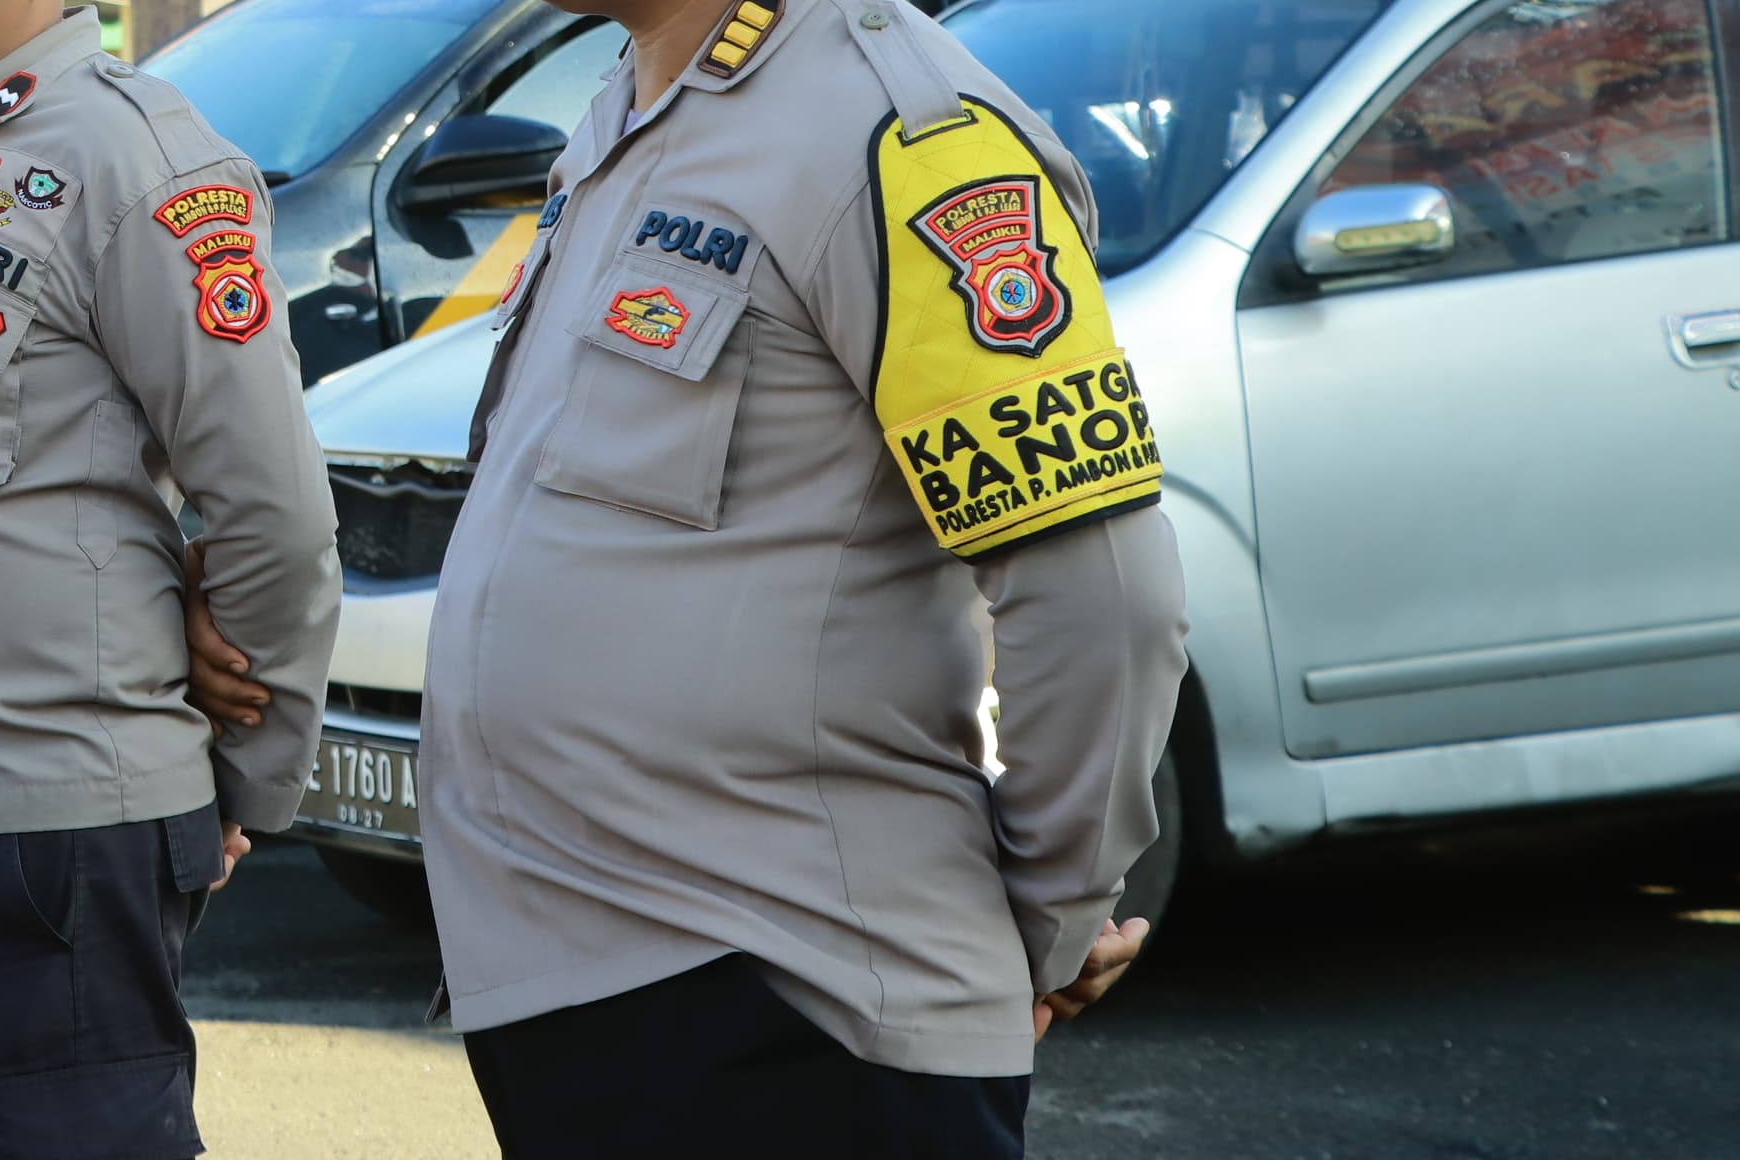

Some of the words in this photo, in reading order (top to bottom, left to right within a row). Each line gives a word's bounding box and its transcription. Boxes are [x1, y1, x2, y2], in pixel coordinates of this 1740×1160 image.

[18, 189, 53, 209] NARCOTIC
[163, 190, 247, 222] POLRESTA
[935, 191, 1021, 229] POLRESTA
[193, 234, 251, 257] MALUKU
[636, 211, 749, 275] POLRI
[962, 225, 1021, 252] MALUKU
[901, 417, 980, 474] KA
[990, 359, 1141, 438] SATG
[919, 400, 1155, 512] BANOP
[936, 485, 1028, 536] POLRESTA
[1028, 477, 1052, 502] P.
[1056, 449, 1132, 492] AMBON
[1130, 446, 1144, 469] &
[331, 745, 392, 804] 1760
[401, 754, 420, 809] A
